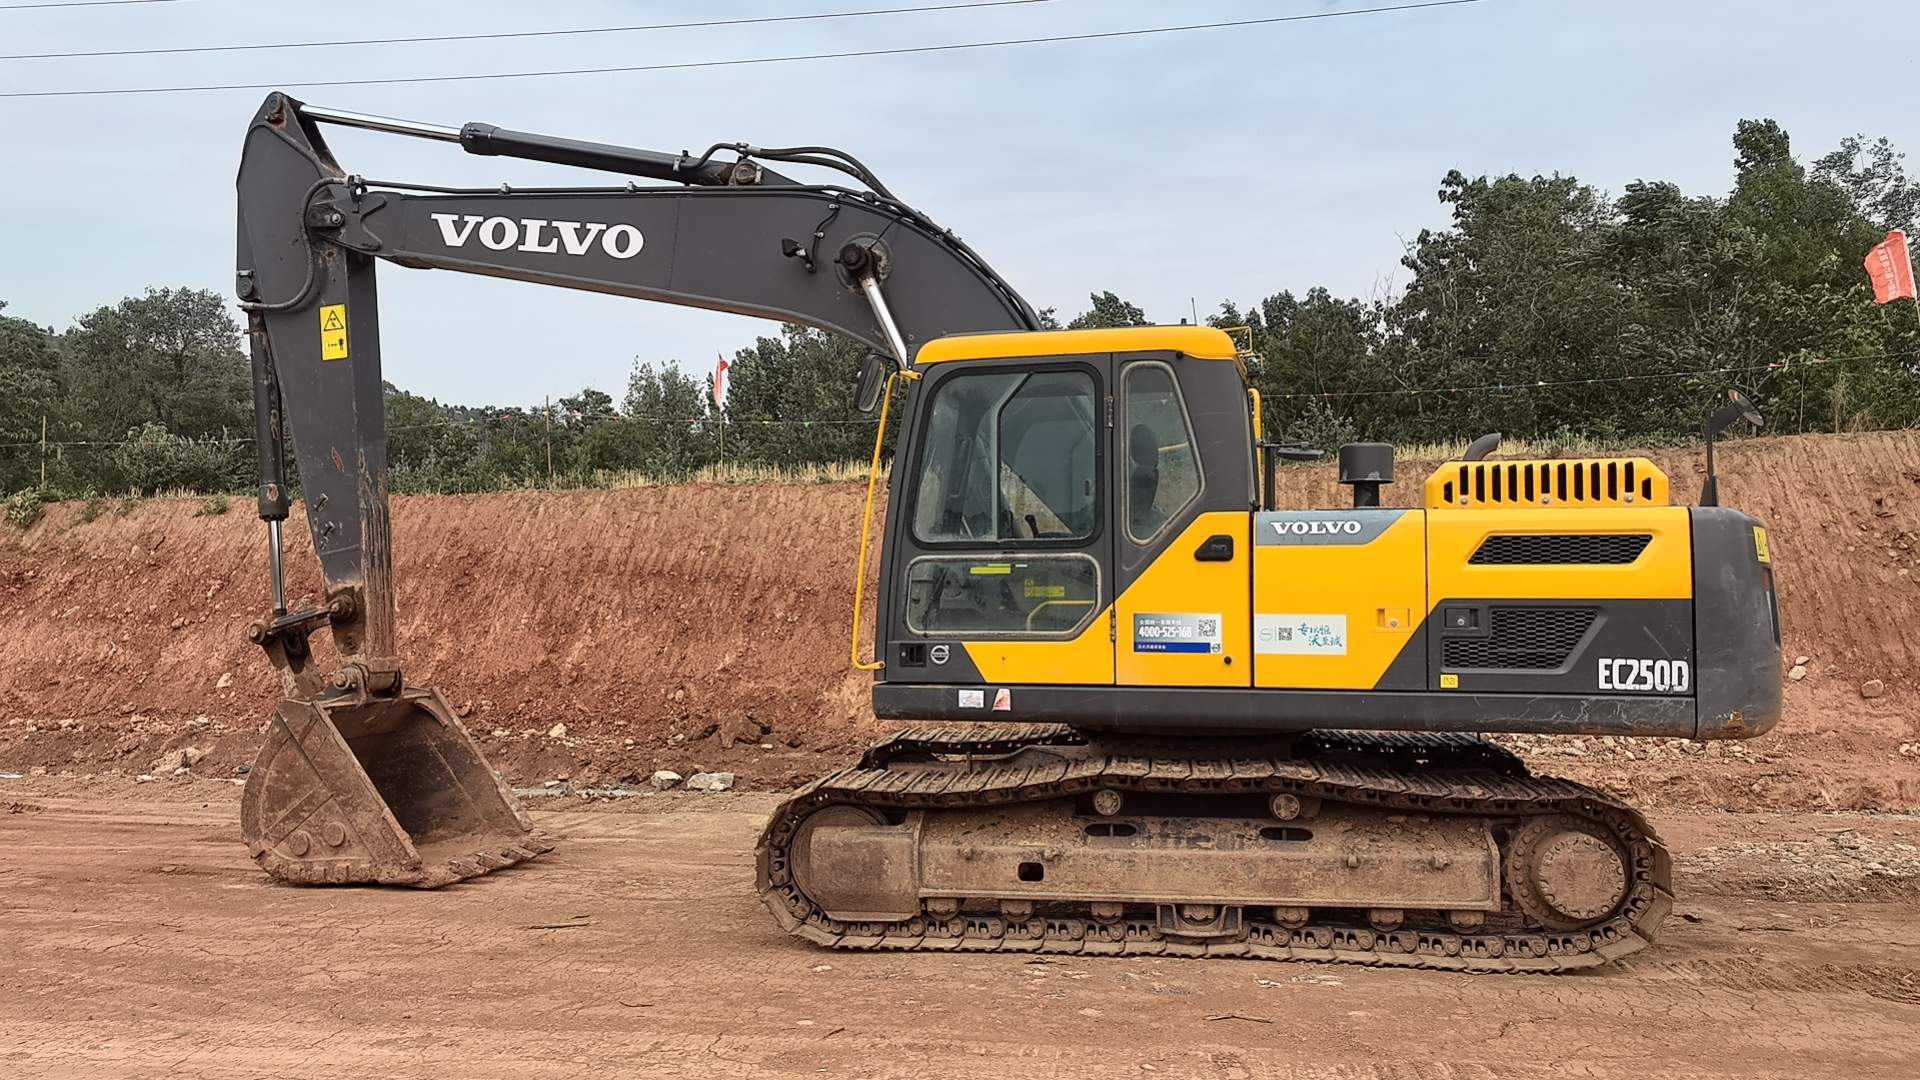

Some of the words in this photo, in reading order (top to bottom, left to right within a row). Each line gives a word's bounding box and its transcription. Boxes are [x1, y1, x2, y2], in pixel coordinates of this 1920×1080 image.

[430, 213, 644, 259] VOLVO
[1271, 521, 1362, 535] VOLVO
[1138, 626, 1192, 638] 4000-525-168
[1598, 659, 1689, 692] EC250D
